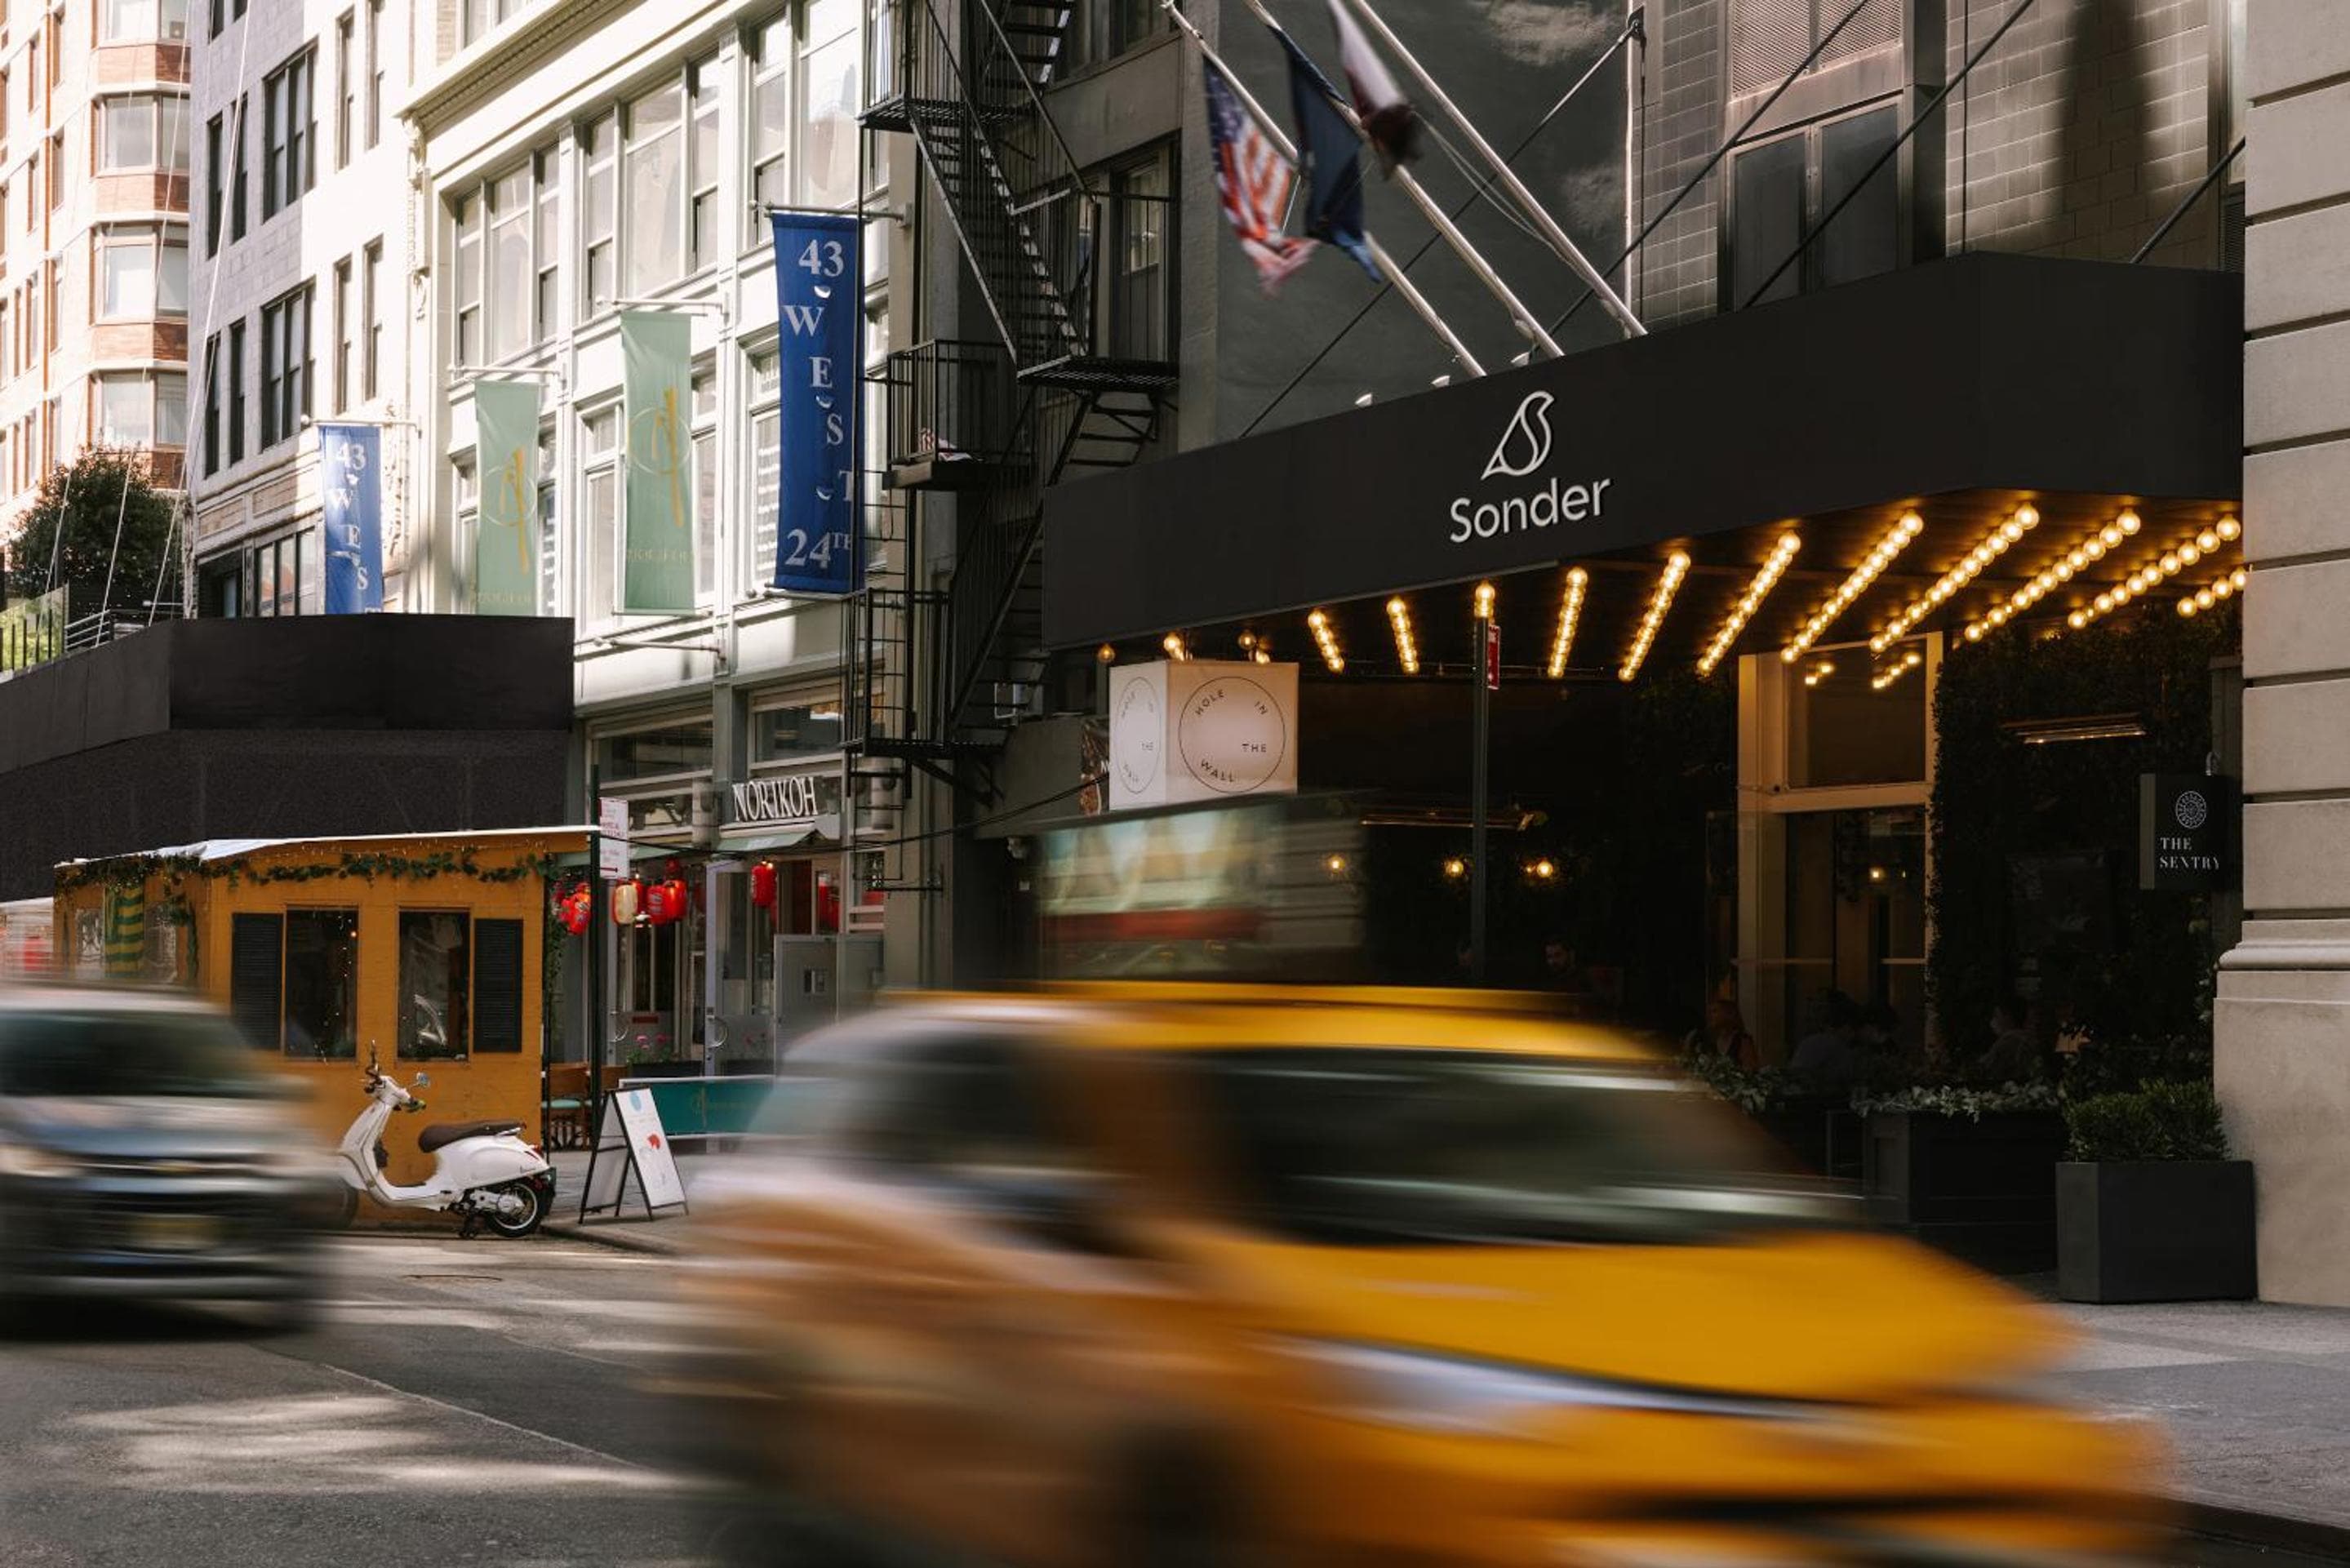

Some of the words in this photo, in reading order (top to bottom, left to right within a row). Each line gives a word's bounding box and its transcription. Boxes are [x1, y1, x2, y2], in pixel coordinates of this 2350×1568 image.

[797, 239, 845, 278] 43
[336, 443, 366, 471] 43
[1450, 478, 1611, 543] Sonder
[1195, 689, 1224, 717] HOLE
[1254, 700, 1268, 716] IN
[1242, 743, 1267, 753] THE
[1201, 759, 1235, 782] WALL
[731, 776, 818, 822] NORIKOH
[2160, 837, 2192, 851] THE
[2159, 856, 2219, 870] SENTRY
